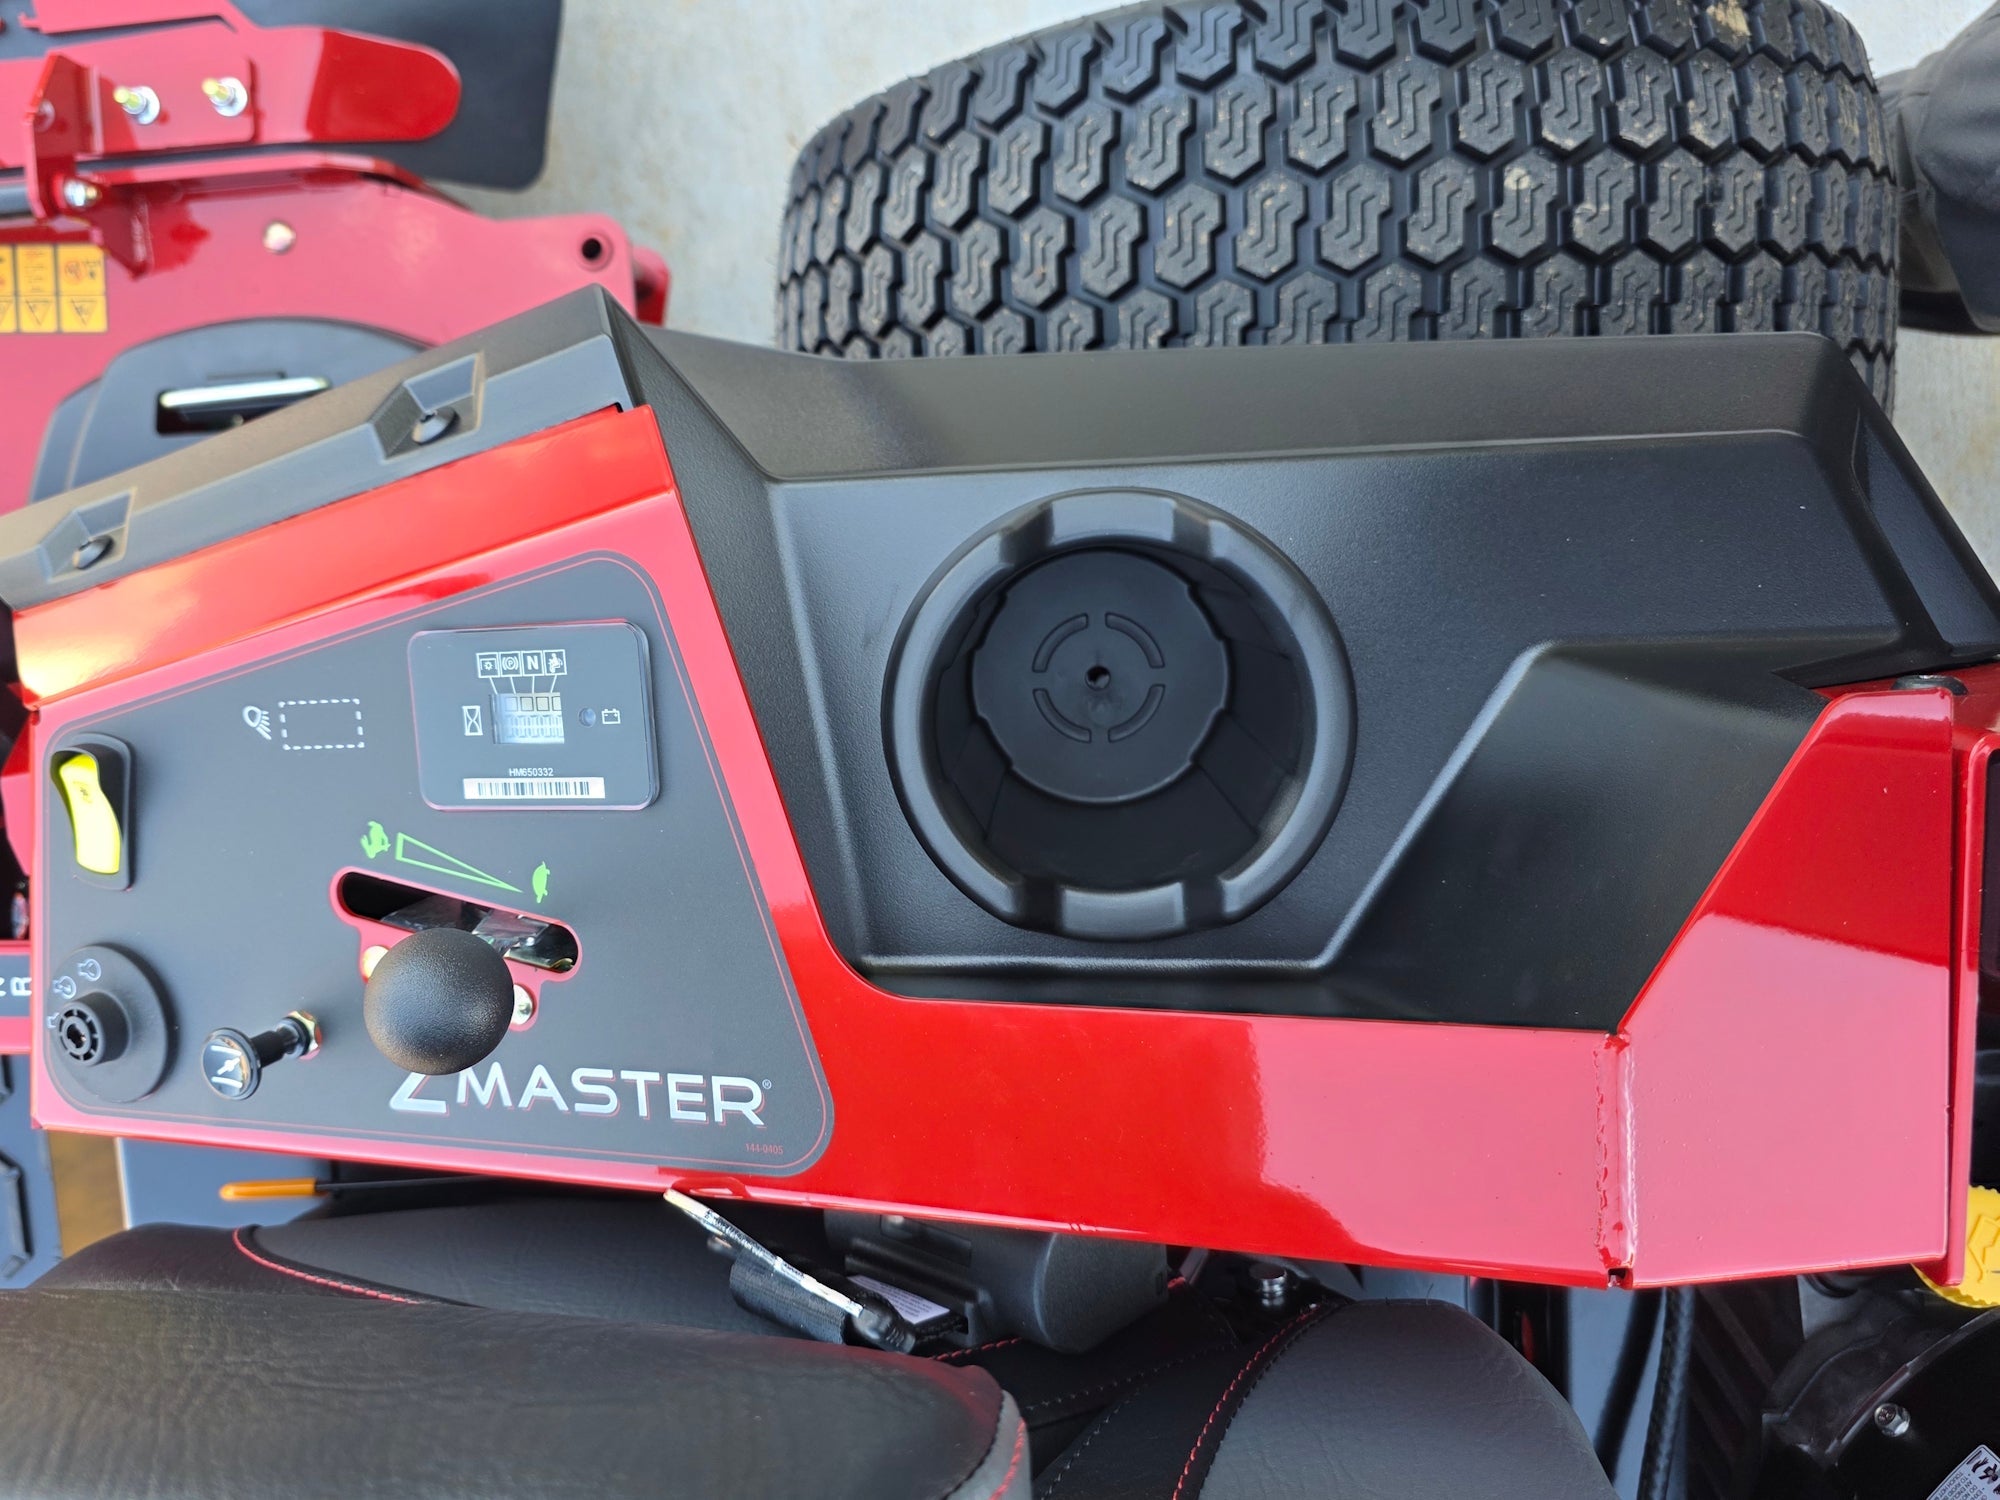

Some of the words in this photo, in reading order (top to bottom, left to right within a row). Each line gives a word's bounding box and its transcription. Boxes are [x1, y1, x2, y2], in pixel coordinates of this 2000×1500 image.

[527, 656, 540, 671] N
[508, 766, 554, 777] HM650332
[456, 1061, 765, 1127] MASTER
